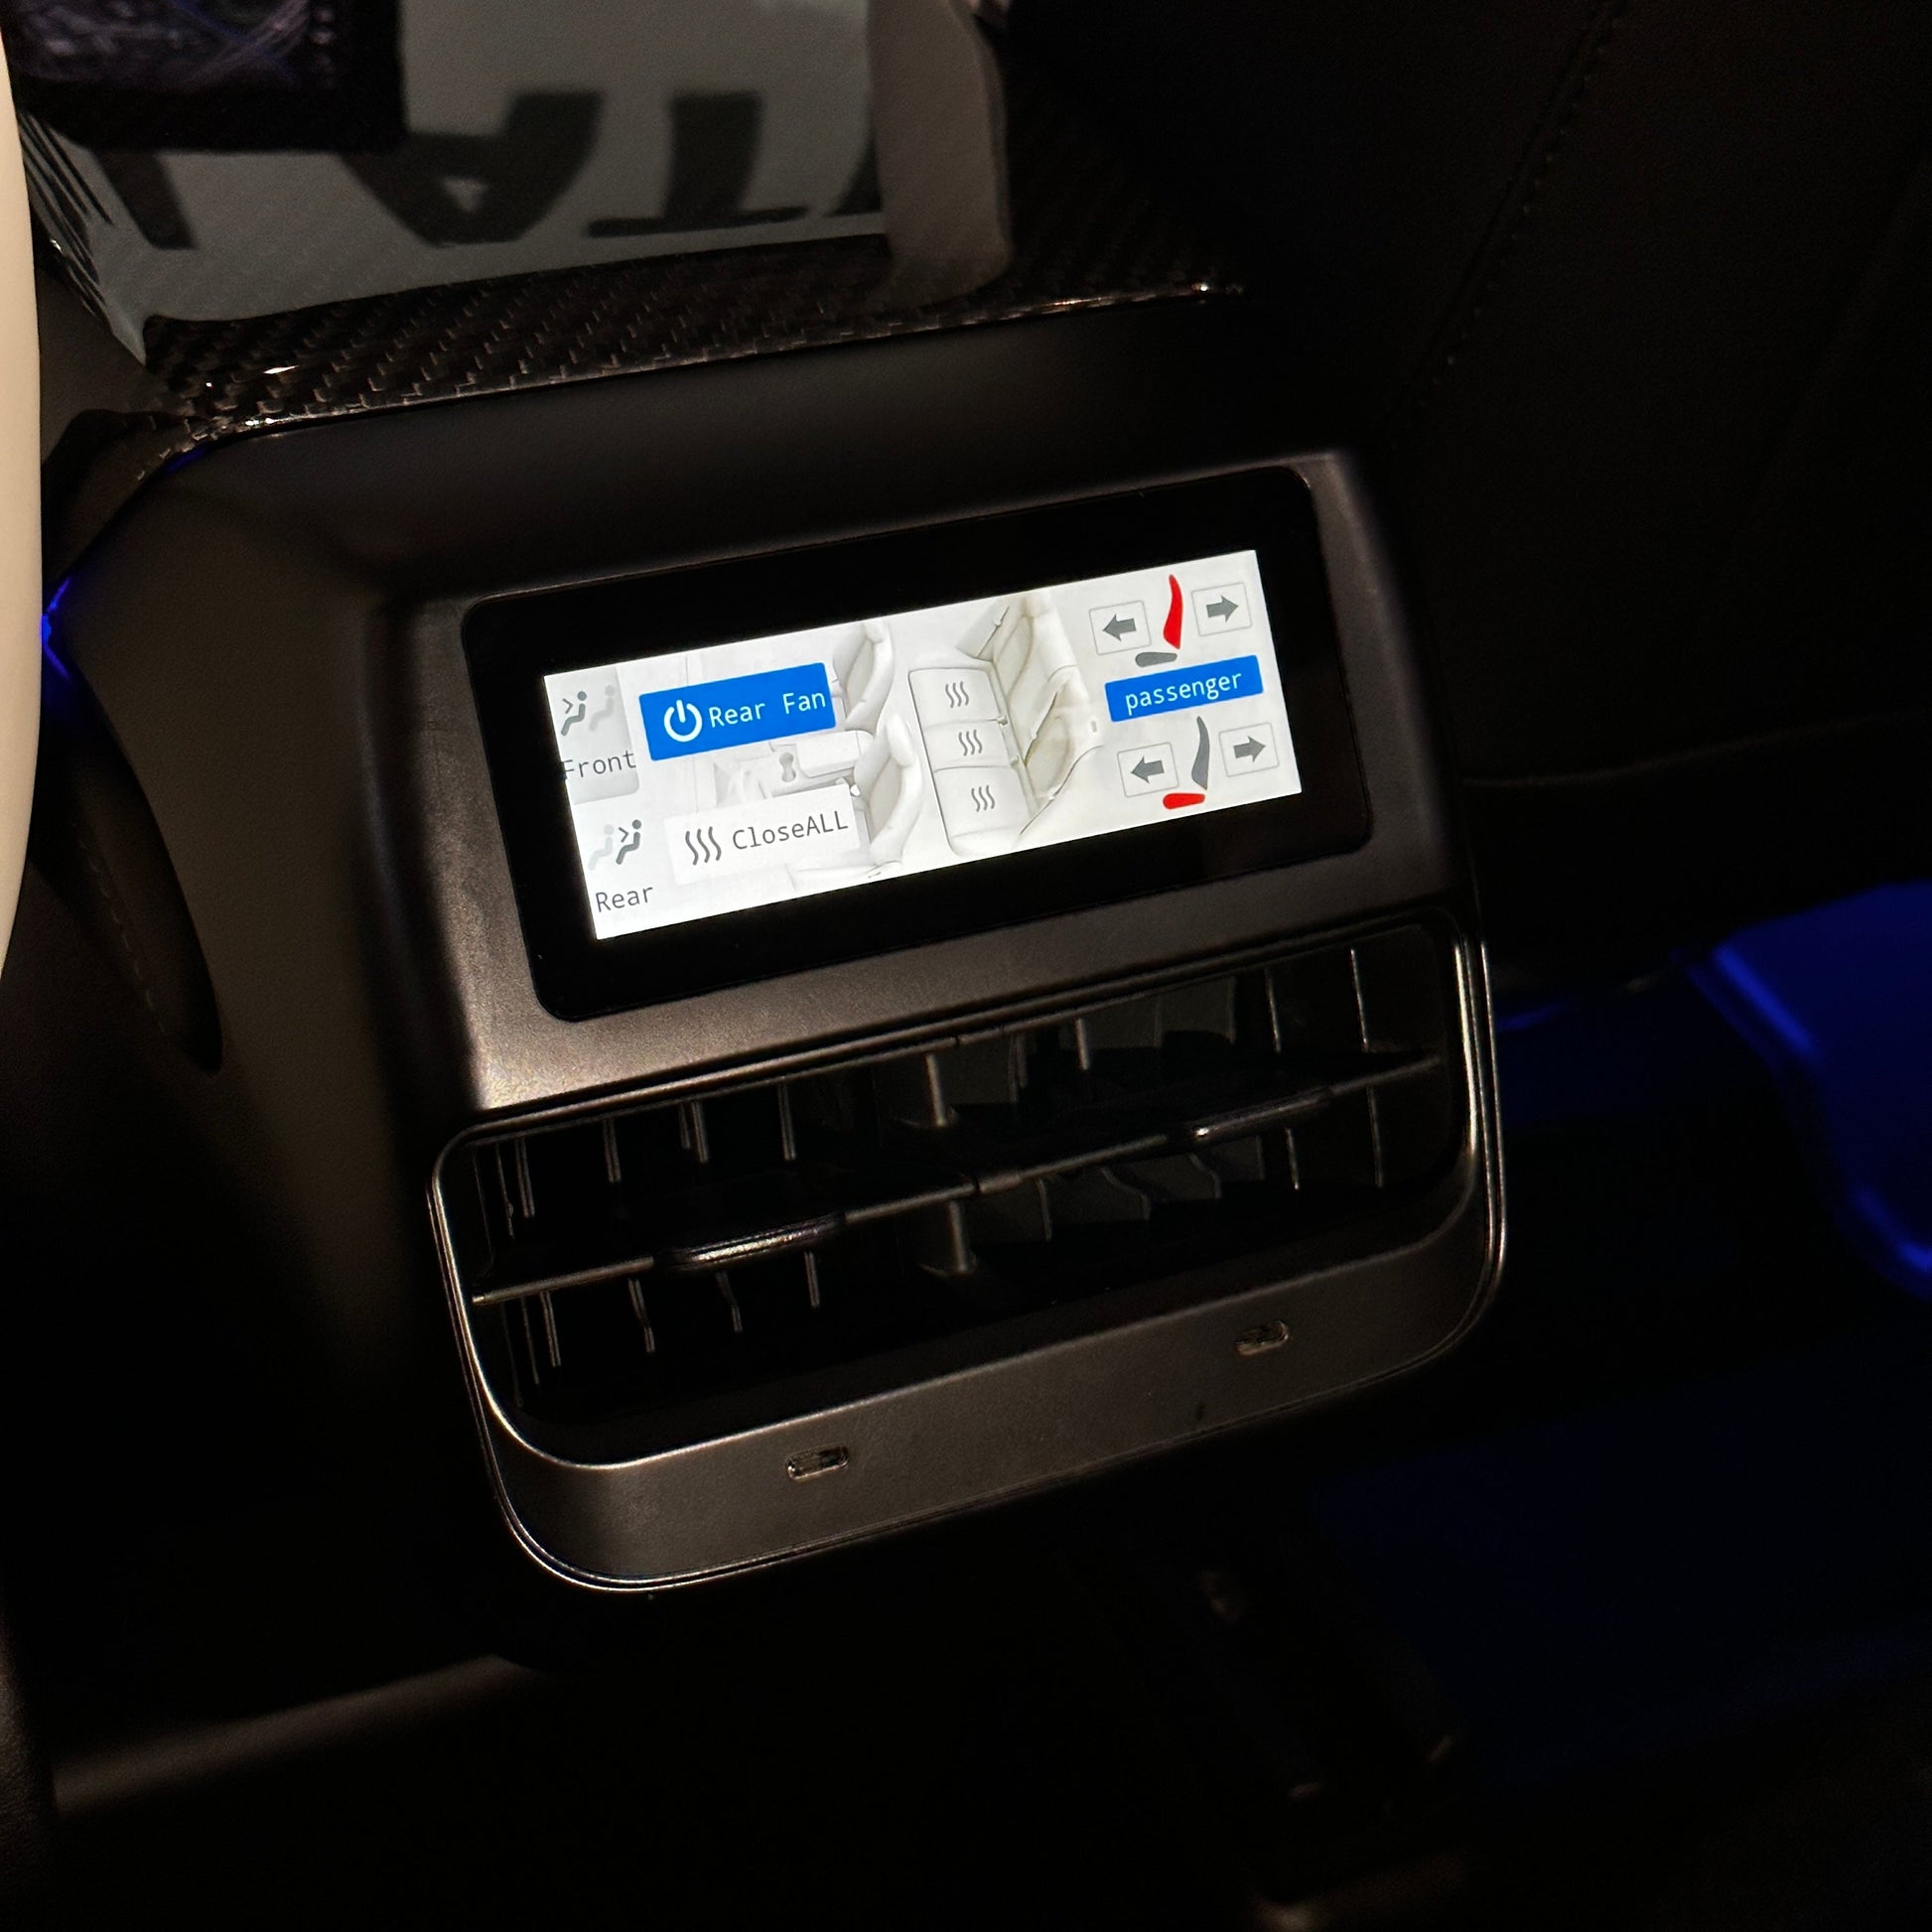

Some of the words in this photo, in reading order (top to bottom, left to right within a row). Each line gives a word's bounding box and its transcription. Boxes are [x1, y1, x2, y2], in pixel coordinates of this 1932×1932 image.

[708, 700, 766, 729] Rear
[782, 692, 827, 714] Fan
[1125, 670, 1243, 716] passenger
[561, 750, 637, 779] Front
[732, 810, 849, 851] CloseALL
[595, 886, 654, 913] Rear
